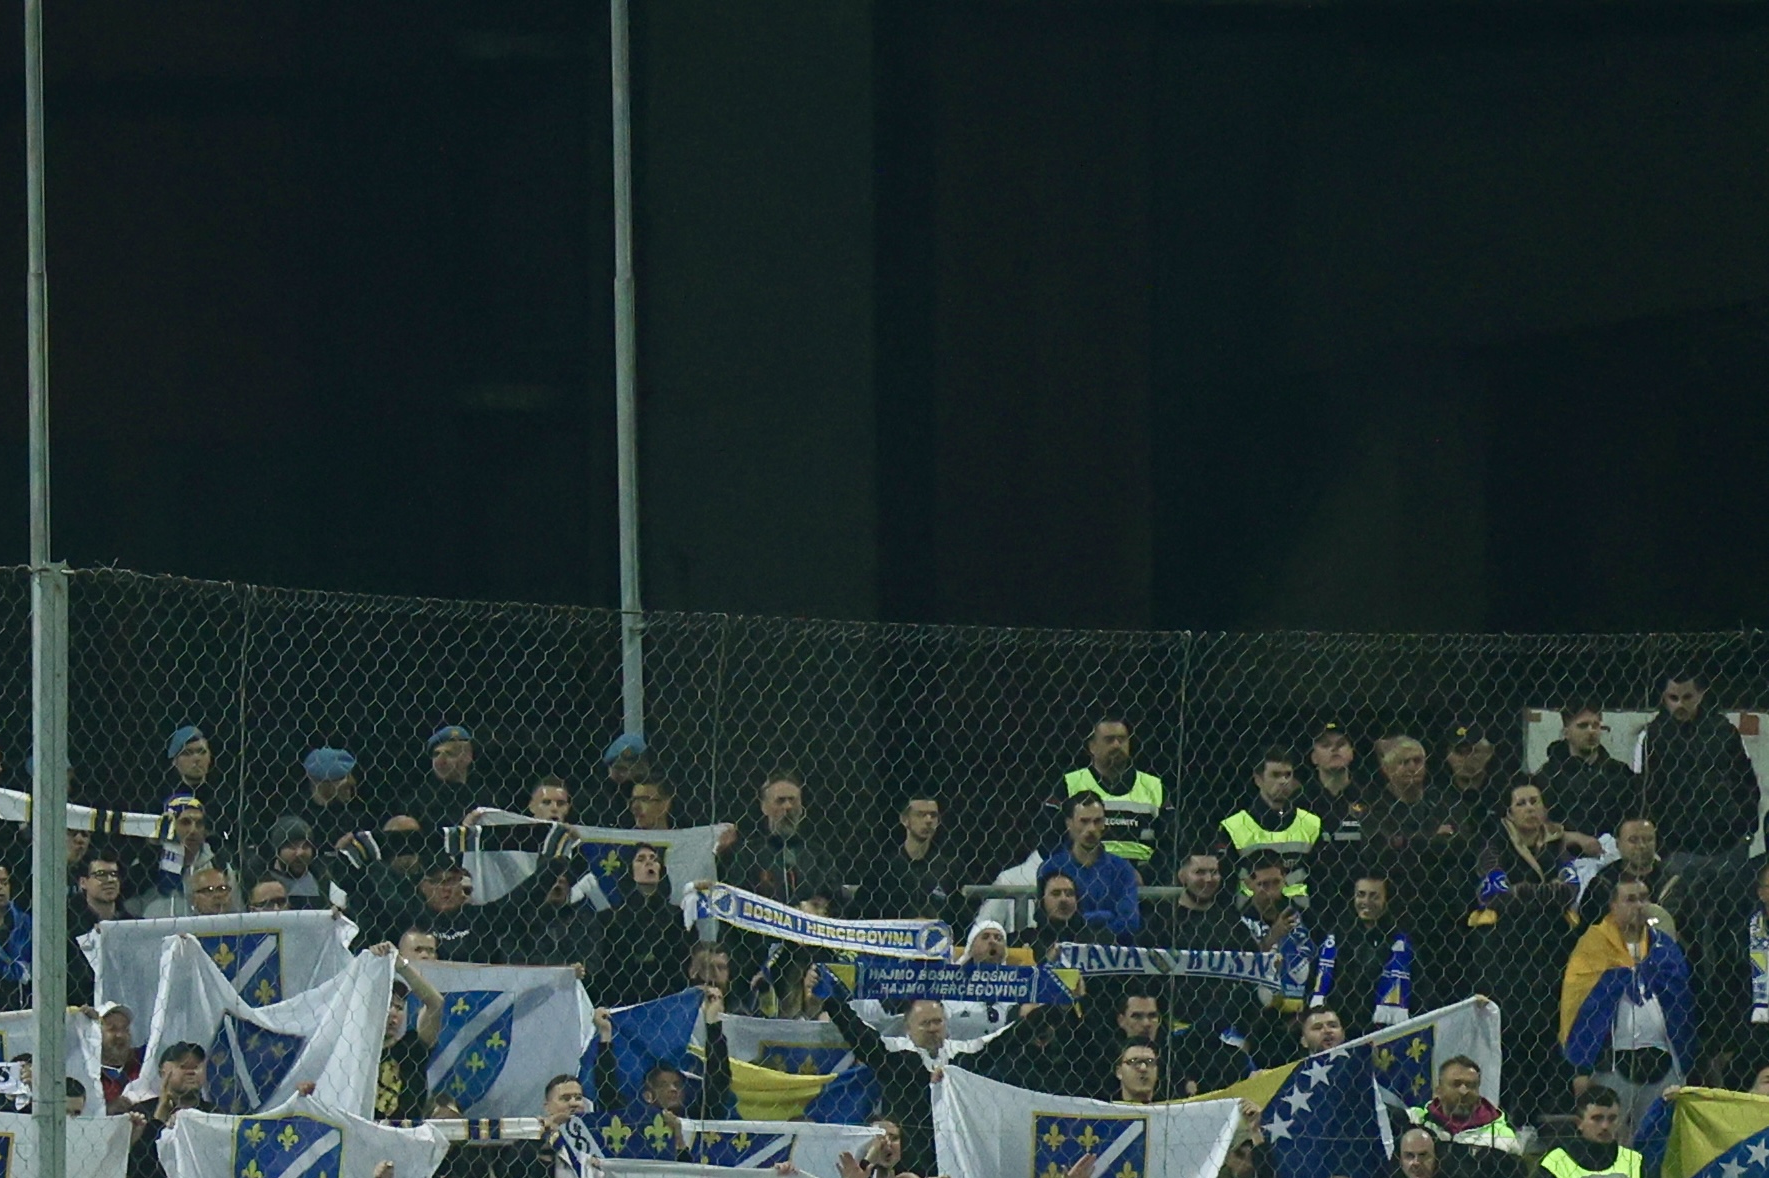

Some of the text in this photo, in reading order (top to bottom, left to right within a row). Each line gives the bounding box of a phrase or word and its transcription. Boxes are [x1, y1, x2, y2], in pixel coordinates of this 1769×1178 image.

[743, 900, 794, 930] BOSNA
[806, 920, 914, 947] HERCEGOVINA
[869, 968, 915, 981] HAJMO
